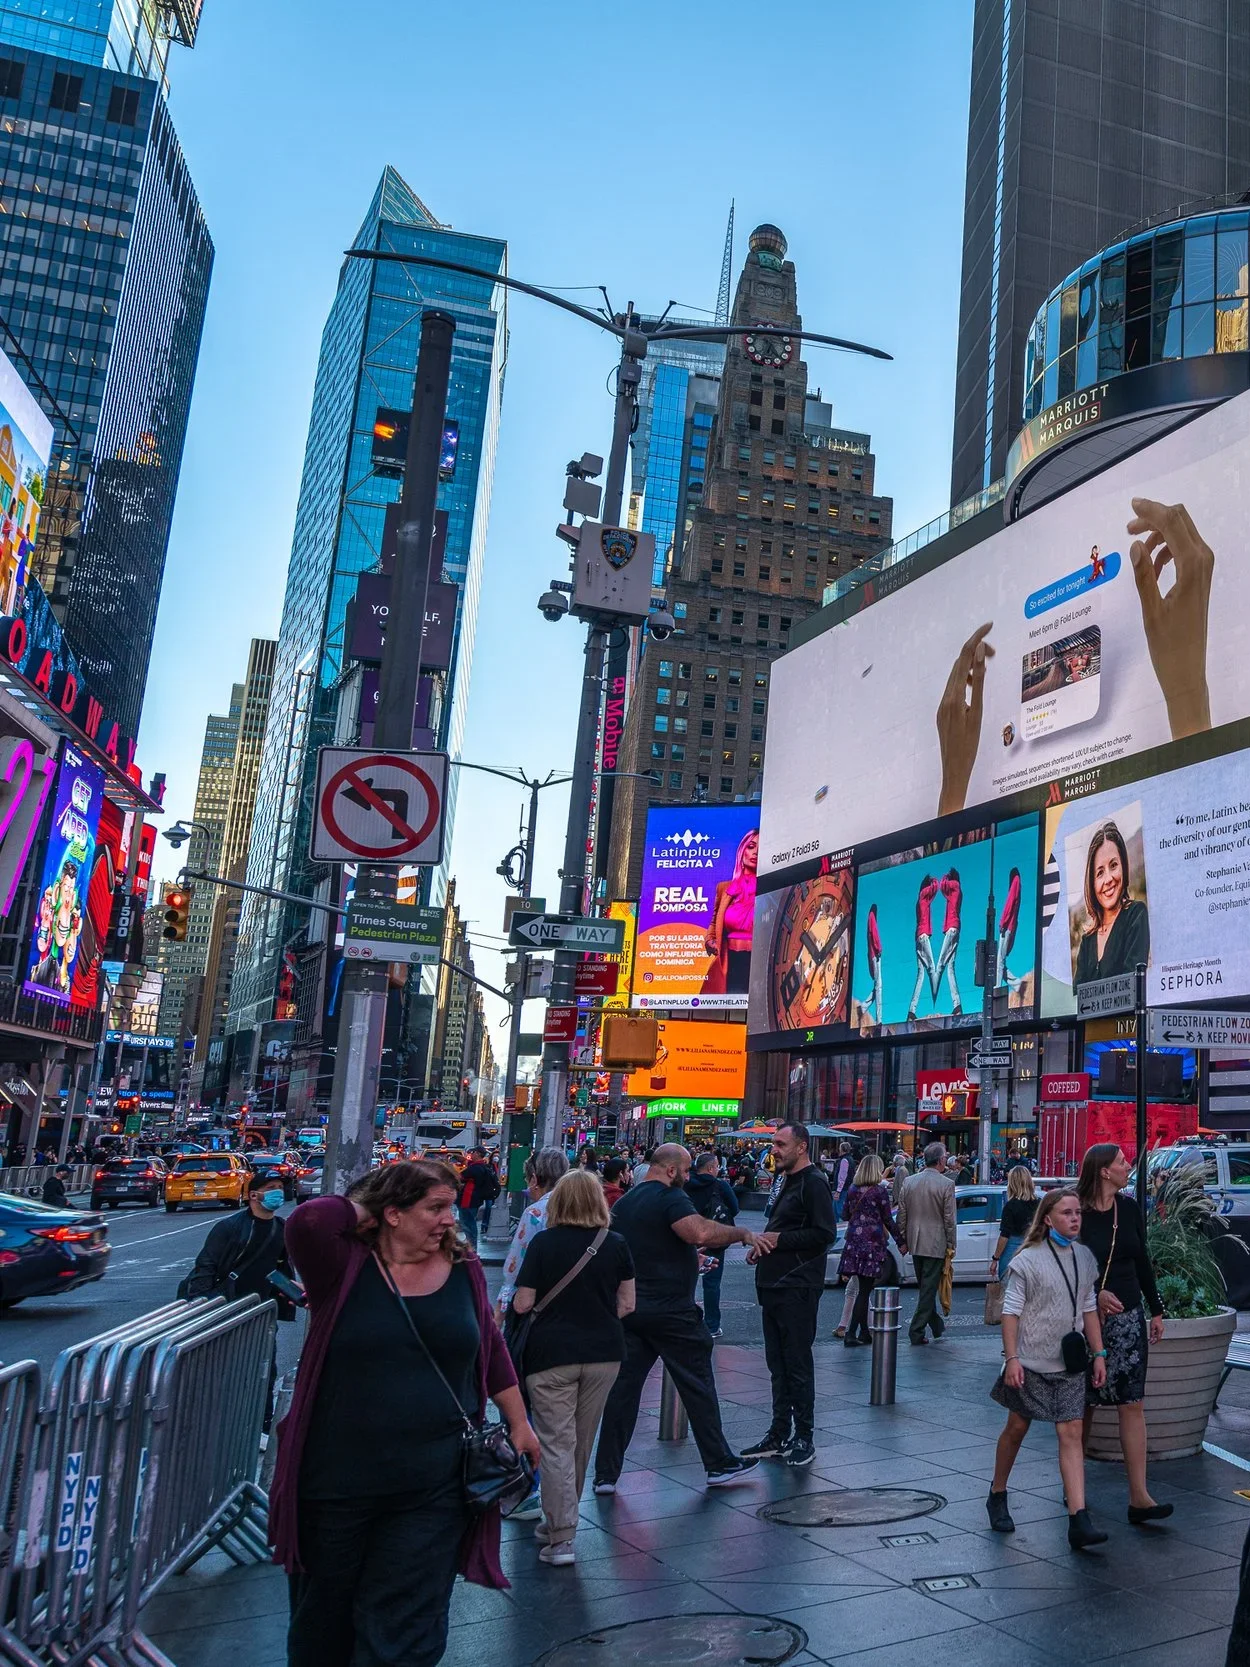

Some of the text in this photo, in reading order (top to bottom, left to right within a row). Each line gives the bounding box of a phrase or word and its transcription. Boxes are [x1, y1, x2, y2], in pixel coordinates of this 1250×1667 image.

[1040, 384, 1109, 429] MARRIOTT
[1039, 406, 1099, 446] MARQUIS
[1029, 601, 1037, 610] So
[1066, 576, 1086, 593] tonight
[1072, 605, 1092, 620] Lounge
[1065, 770, 1100, 787] MARRIOTT
[1064, 782, 1096, 798] MARQUIS
[1195, 811, 1211, 824] me,
[1211, 806, 1237, 821] Latinx
[1159, 838, 1172, 850] the
[1172, 831, 1206, 847] diversity
[1206, 825, 1216, 838] of
[1216, 824, 1232, 836] our
[652, 847, 720, 859] Latinplug
[771, 851, 790, 865] Galaxy
[791, 850, 796, 859] Z
[811, 840, 820, 851] 5G
[831, 849, 855, 862] MARRIOTT
[1183, 848, 1199, 860] and
[1199, 841, 1236, 857] vibrancy
[1236, 836, 1247, 849] of
[656, 859, 714, 868] FELICITA A
[831, 859, 852, 869] MARQUIS
[1206, 865, 1242, 880] Stephanie
[654, 886, 709, 903] REAL
[1194, 885, 1234, 899] Co-founder,
[652, 903, 709, 912] POMPOSA
[117, 896, 131, 937] 1500
[352, 914, 428, 930] Times Square
[350, 926, 437, 942] Pedestrian Plaza
[529, 924, 609, 942] ONE WAY
[1204, 958, 1222, 967] Month
[576, 972, 594, 980] nytime
[1160, 970, 1223, 991] SEPHORA
[1079, 979, 1131, 1000] PEDESTRIAN FLOW ZONE
[1101, 994, 1131, 1010] KEEP MOVING
[1161, 1015, 1214, 1028] PEDESTRIAN
[1215, 1017, 1237, 1029] FLOW
[994, 1040, 1007, 1048] WAY
[1207, 1032, 1228, 1043] KEEP
[993, 1056, 1007, 1064] WAY
[1048, 1081, 1080, 1093] COFFEED
[702, 1103, 724, 1112] LINE
[58, 1456, 80, 1546] NYPD
[72, 1479, 100, 1569] NYPD
